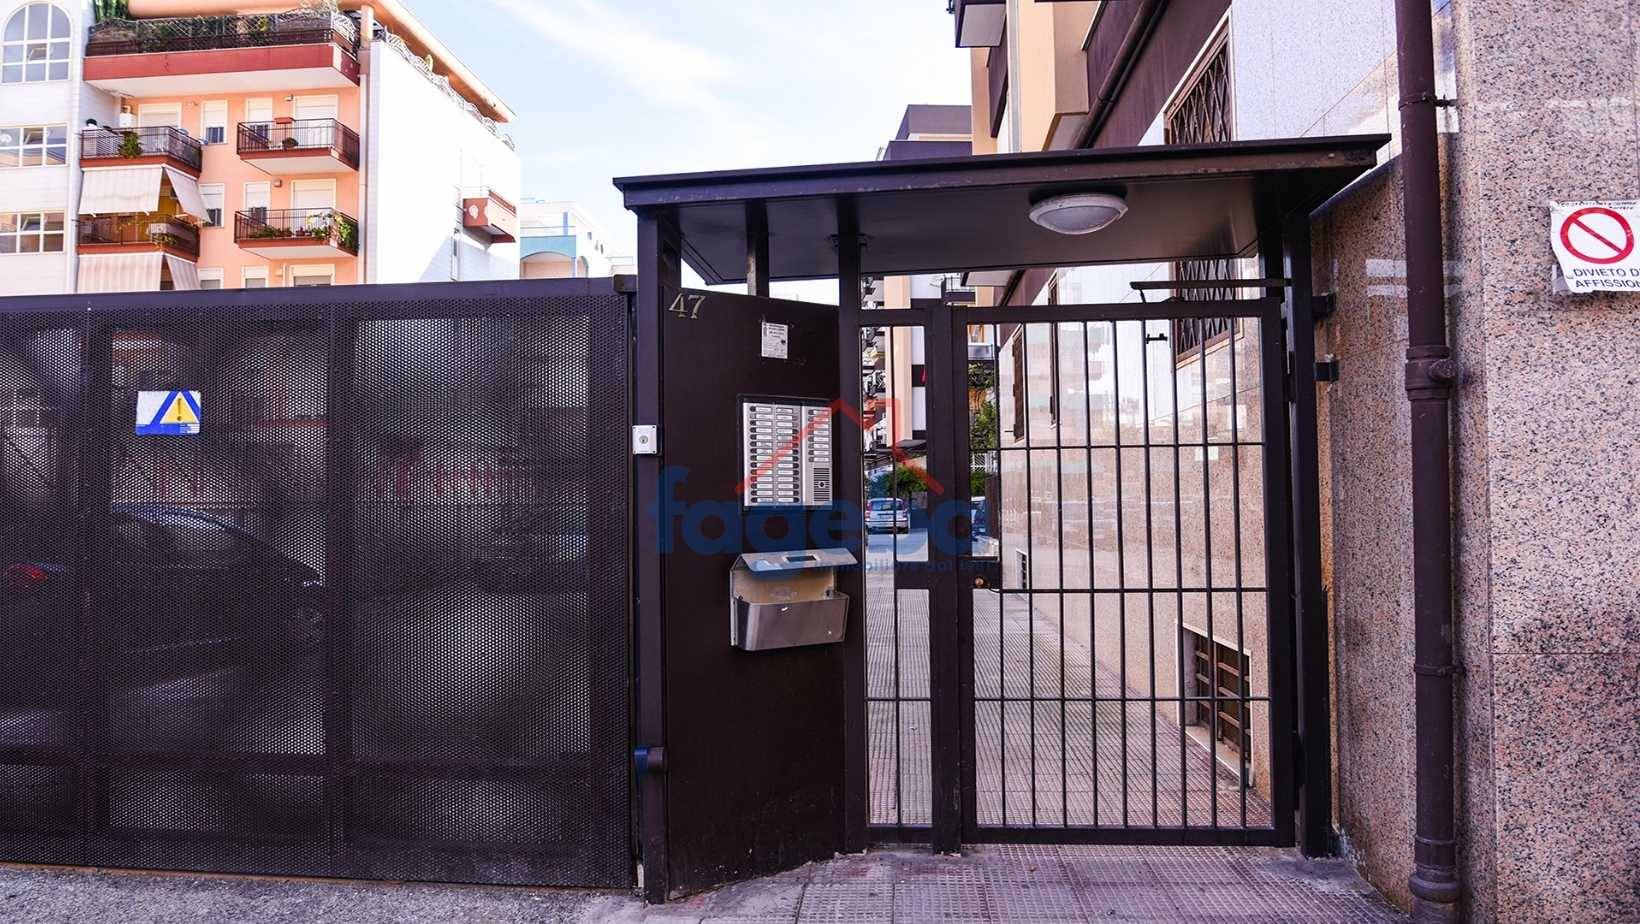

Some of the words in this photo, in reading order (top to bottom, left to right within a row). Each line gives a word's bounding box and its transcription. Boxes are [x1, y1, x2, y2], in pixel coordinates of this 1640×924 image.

[1573, 268, 1626, 277] DIVIETO
[1630, 268, 1640, 277] D
[669, 293, 706, 319] 47
